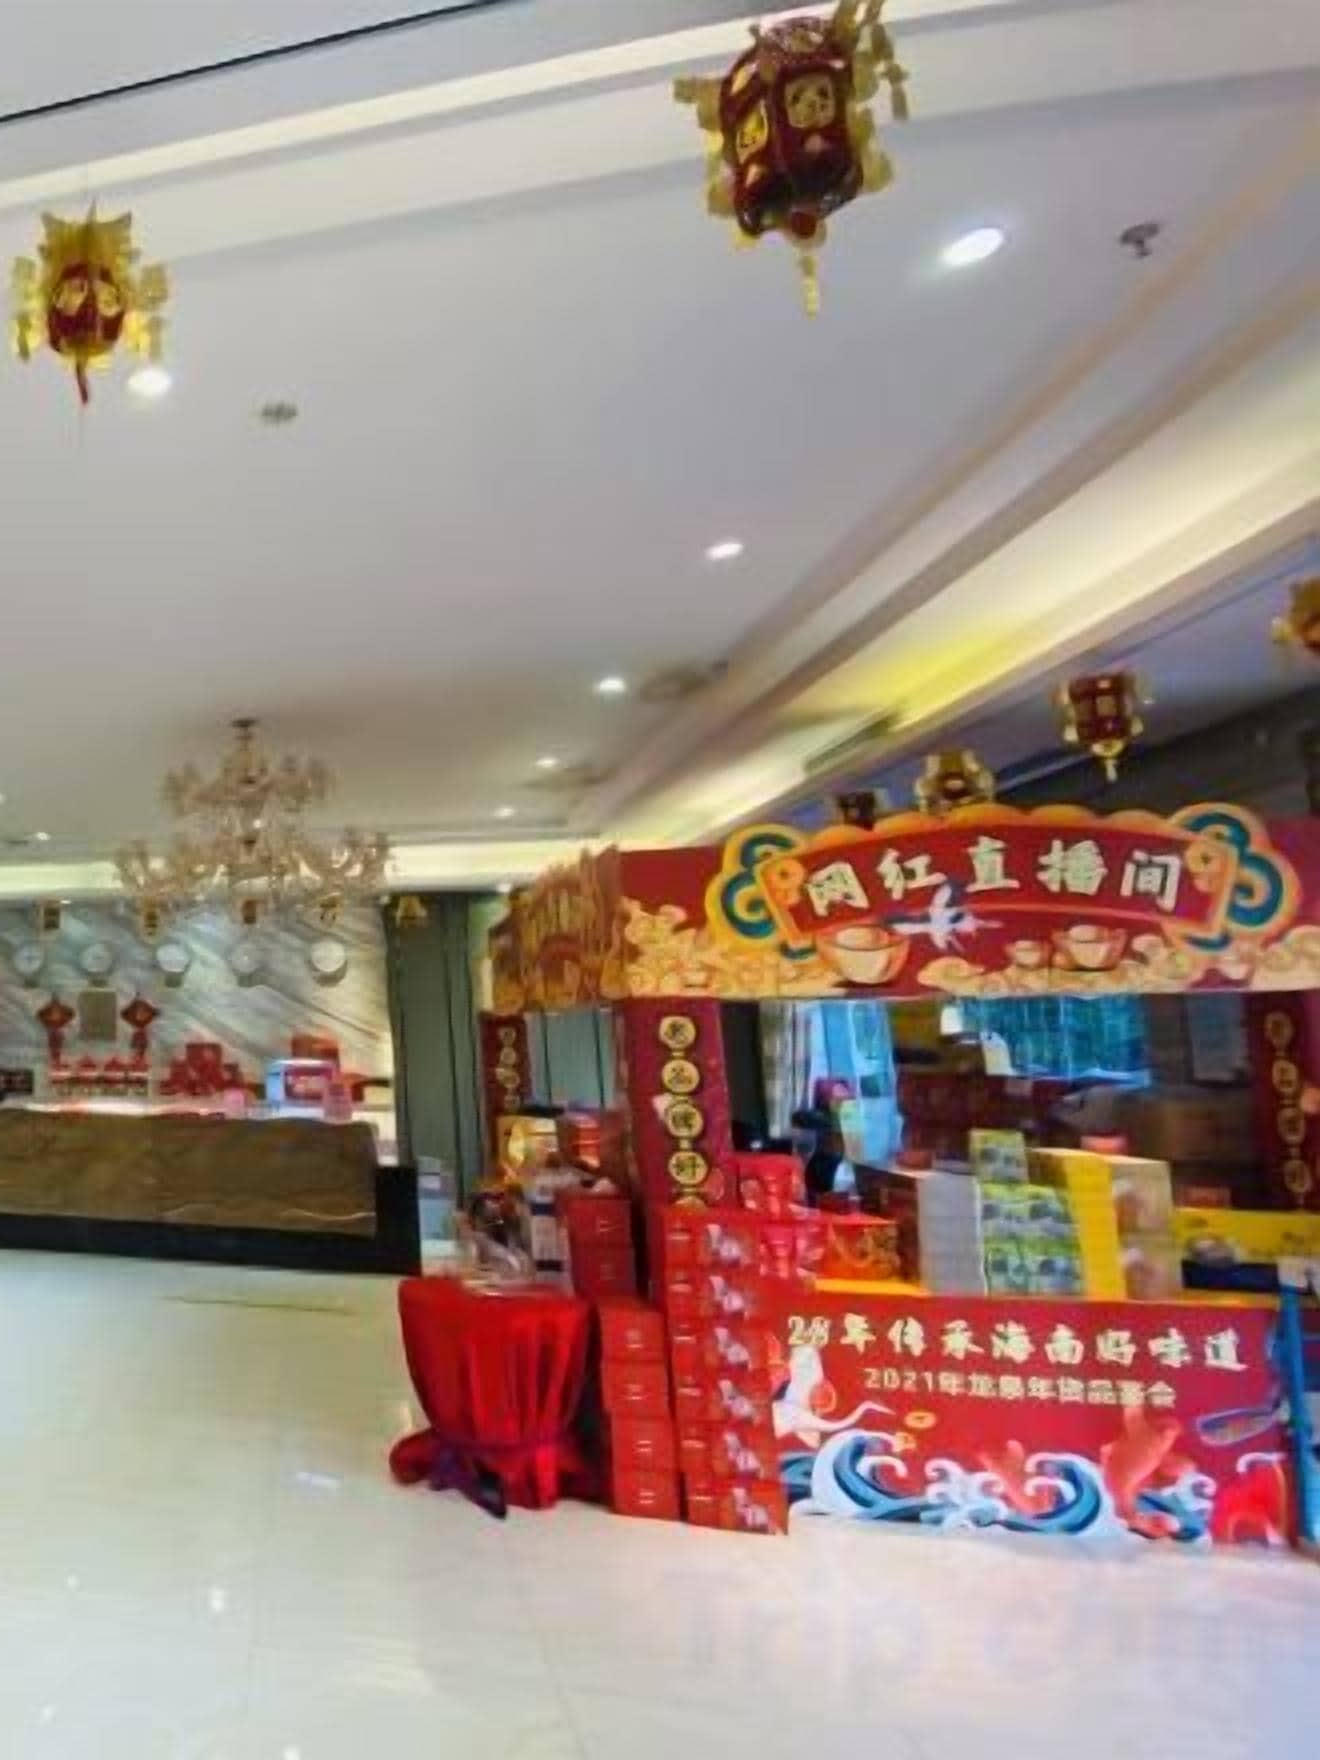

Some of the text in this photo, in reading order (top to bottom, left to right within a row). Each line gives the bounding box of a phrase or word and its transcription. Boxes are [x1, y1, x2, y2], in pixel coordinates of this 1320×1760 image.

[805, 835, 1181, 916] 网红直播间
